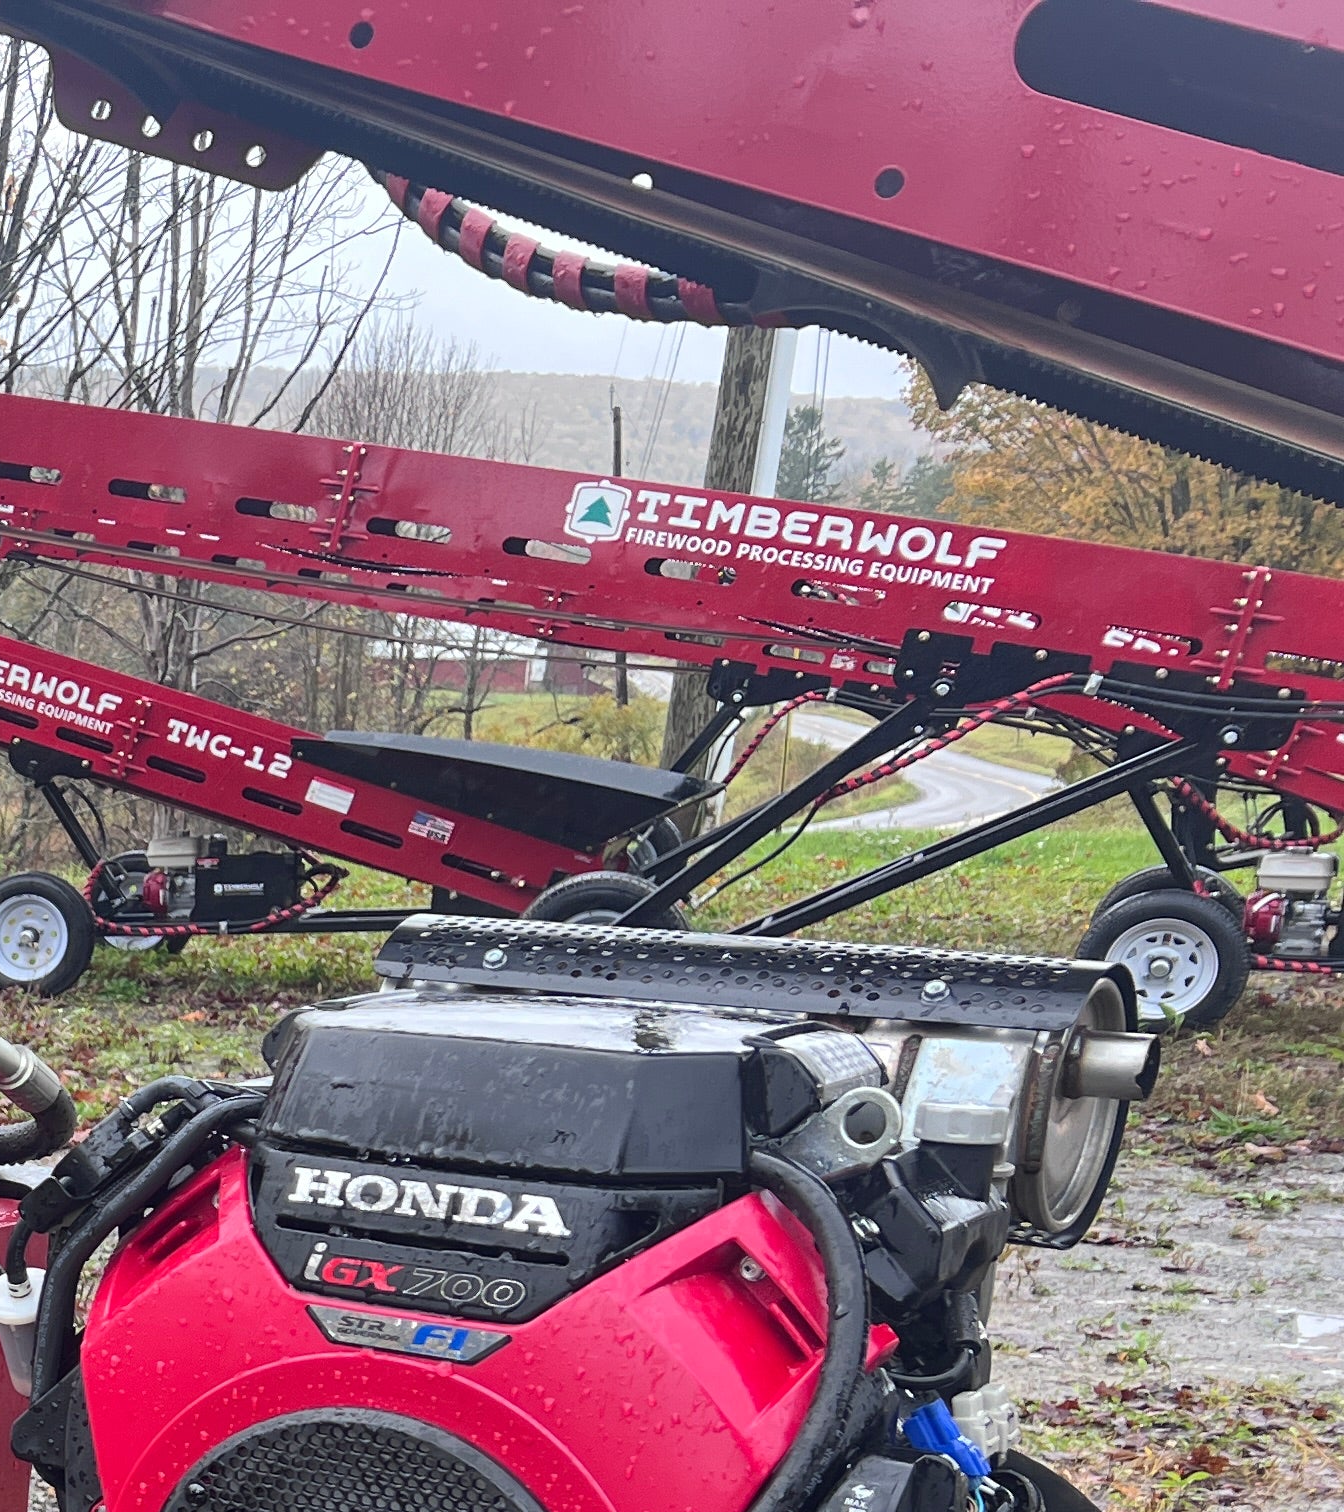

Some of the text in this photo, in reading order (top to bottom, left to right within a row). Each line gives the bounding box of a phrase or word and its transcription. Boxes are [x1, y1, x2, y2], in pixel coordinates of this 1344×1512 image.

[636, 489, 1007, 569] TIMBERWOLF
[624, 527, 996, 595] FIREWOOD PROCESSING EQUIPMENT
[36, 701, 114, 735] EQUIPMENT
[166, 718, 293, 779] TWC-12
[287, 1166, 574, 1239] HONDA
[337, 1327, 401, 1342] GOVERNOR
[338, 1316, 386, 1333] STR
